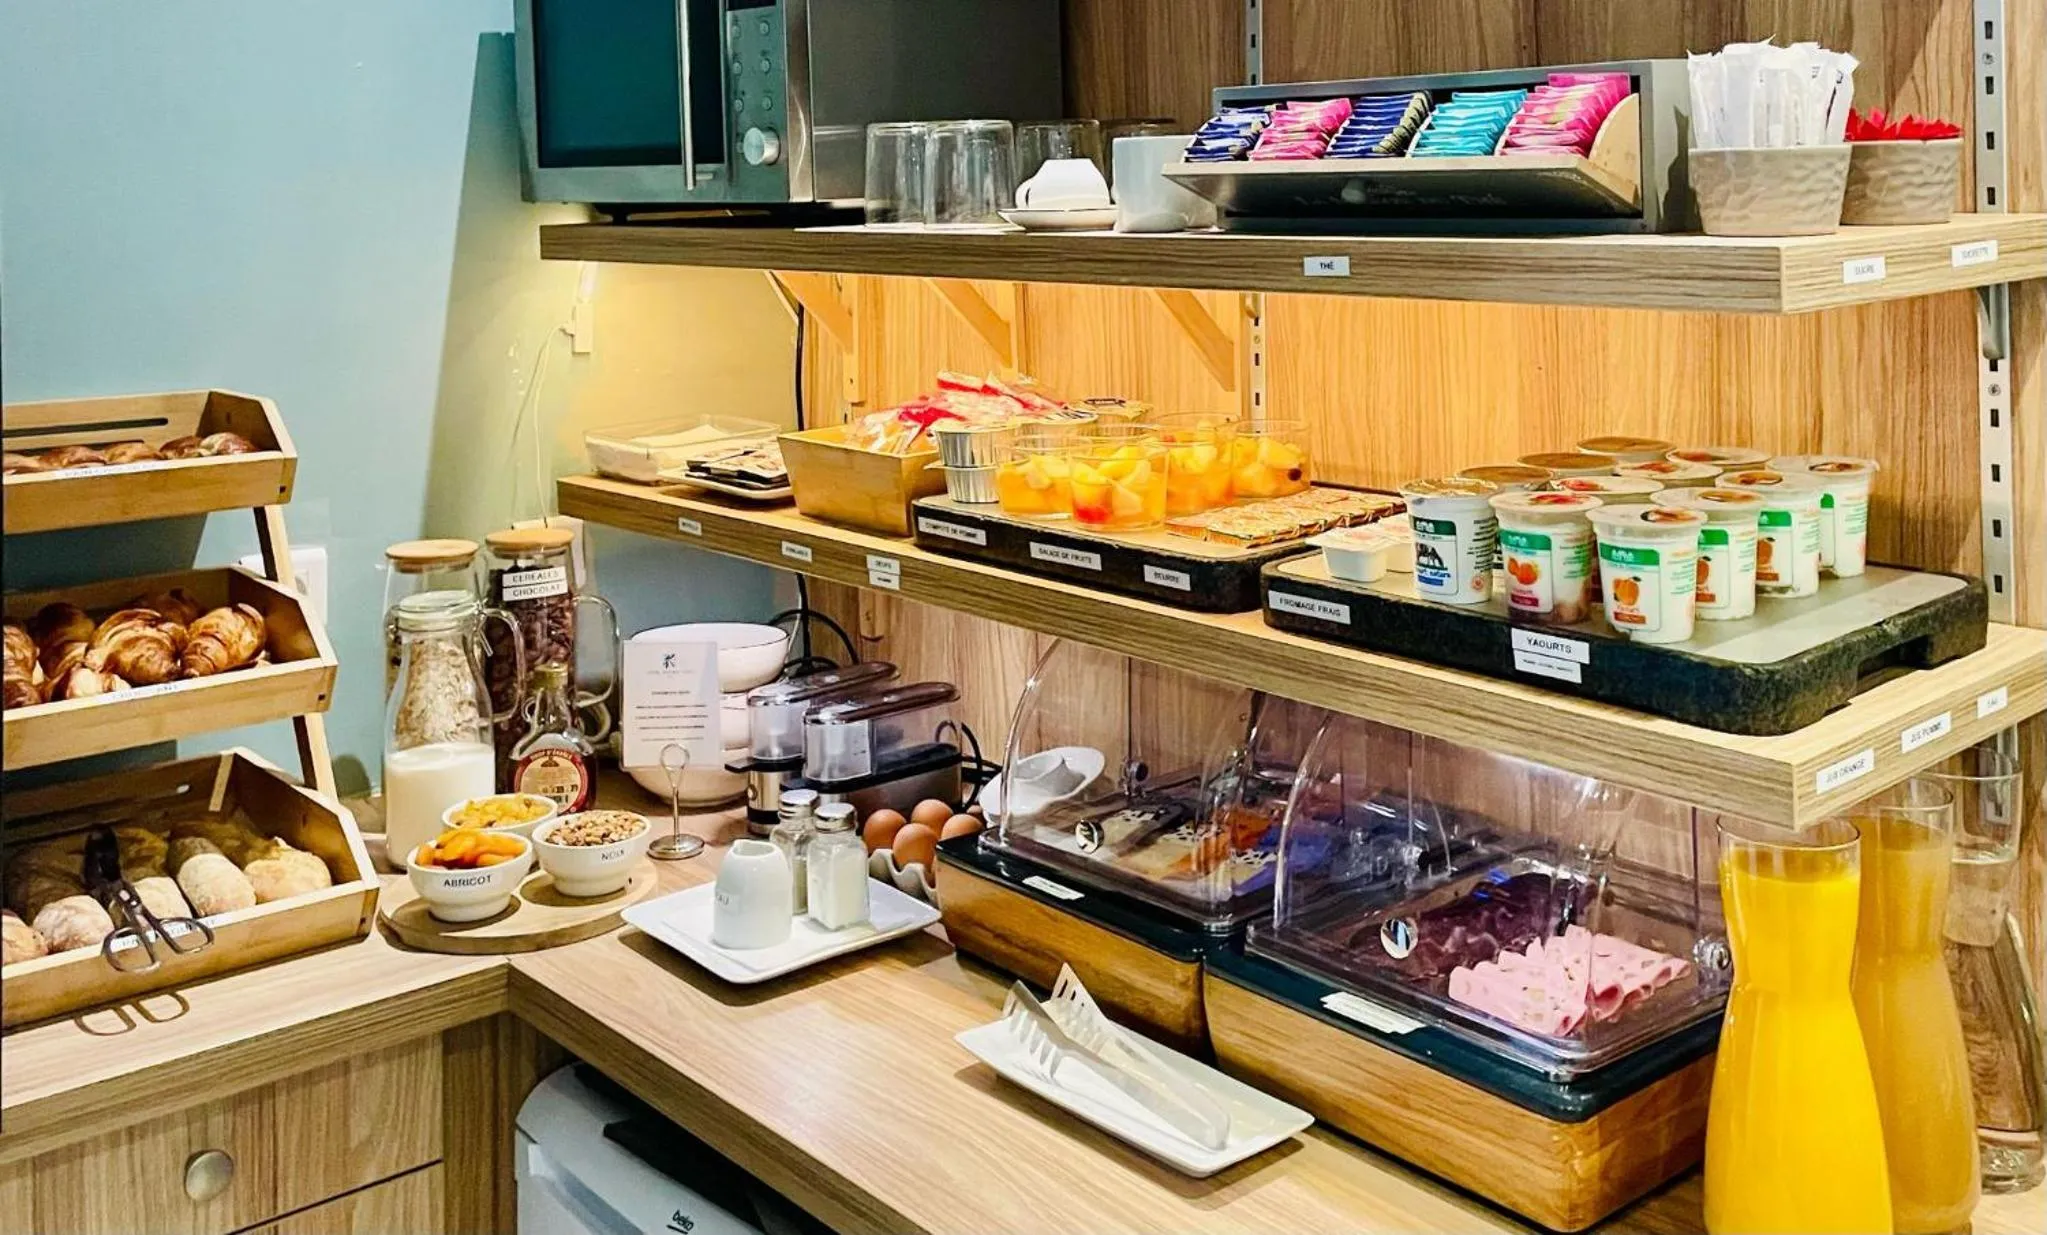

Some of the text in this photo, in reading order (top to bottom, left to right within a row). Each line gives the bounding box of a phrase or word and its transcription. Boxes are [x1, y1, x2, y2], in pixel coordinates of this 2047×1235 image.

[512, 584, 560, 597] CHOCOLAT
[1280, 597, 1341, 617] FROMAGE FRAIS
[1526, 637, 1572, 653] YAOURTS
[444, 874, 491, 887] ABRICOT
[672, 1209, 694, 1231] beko
